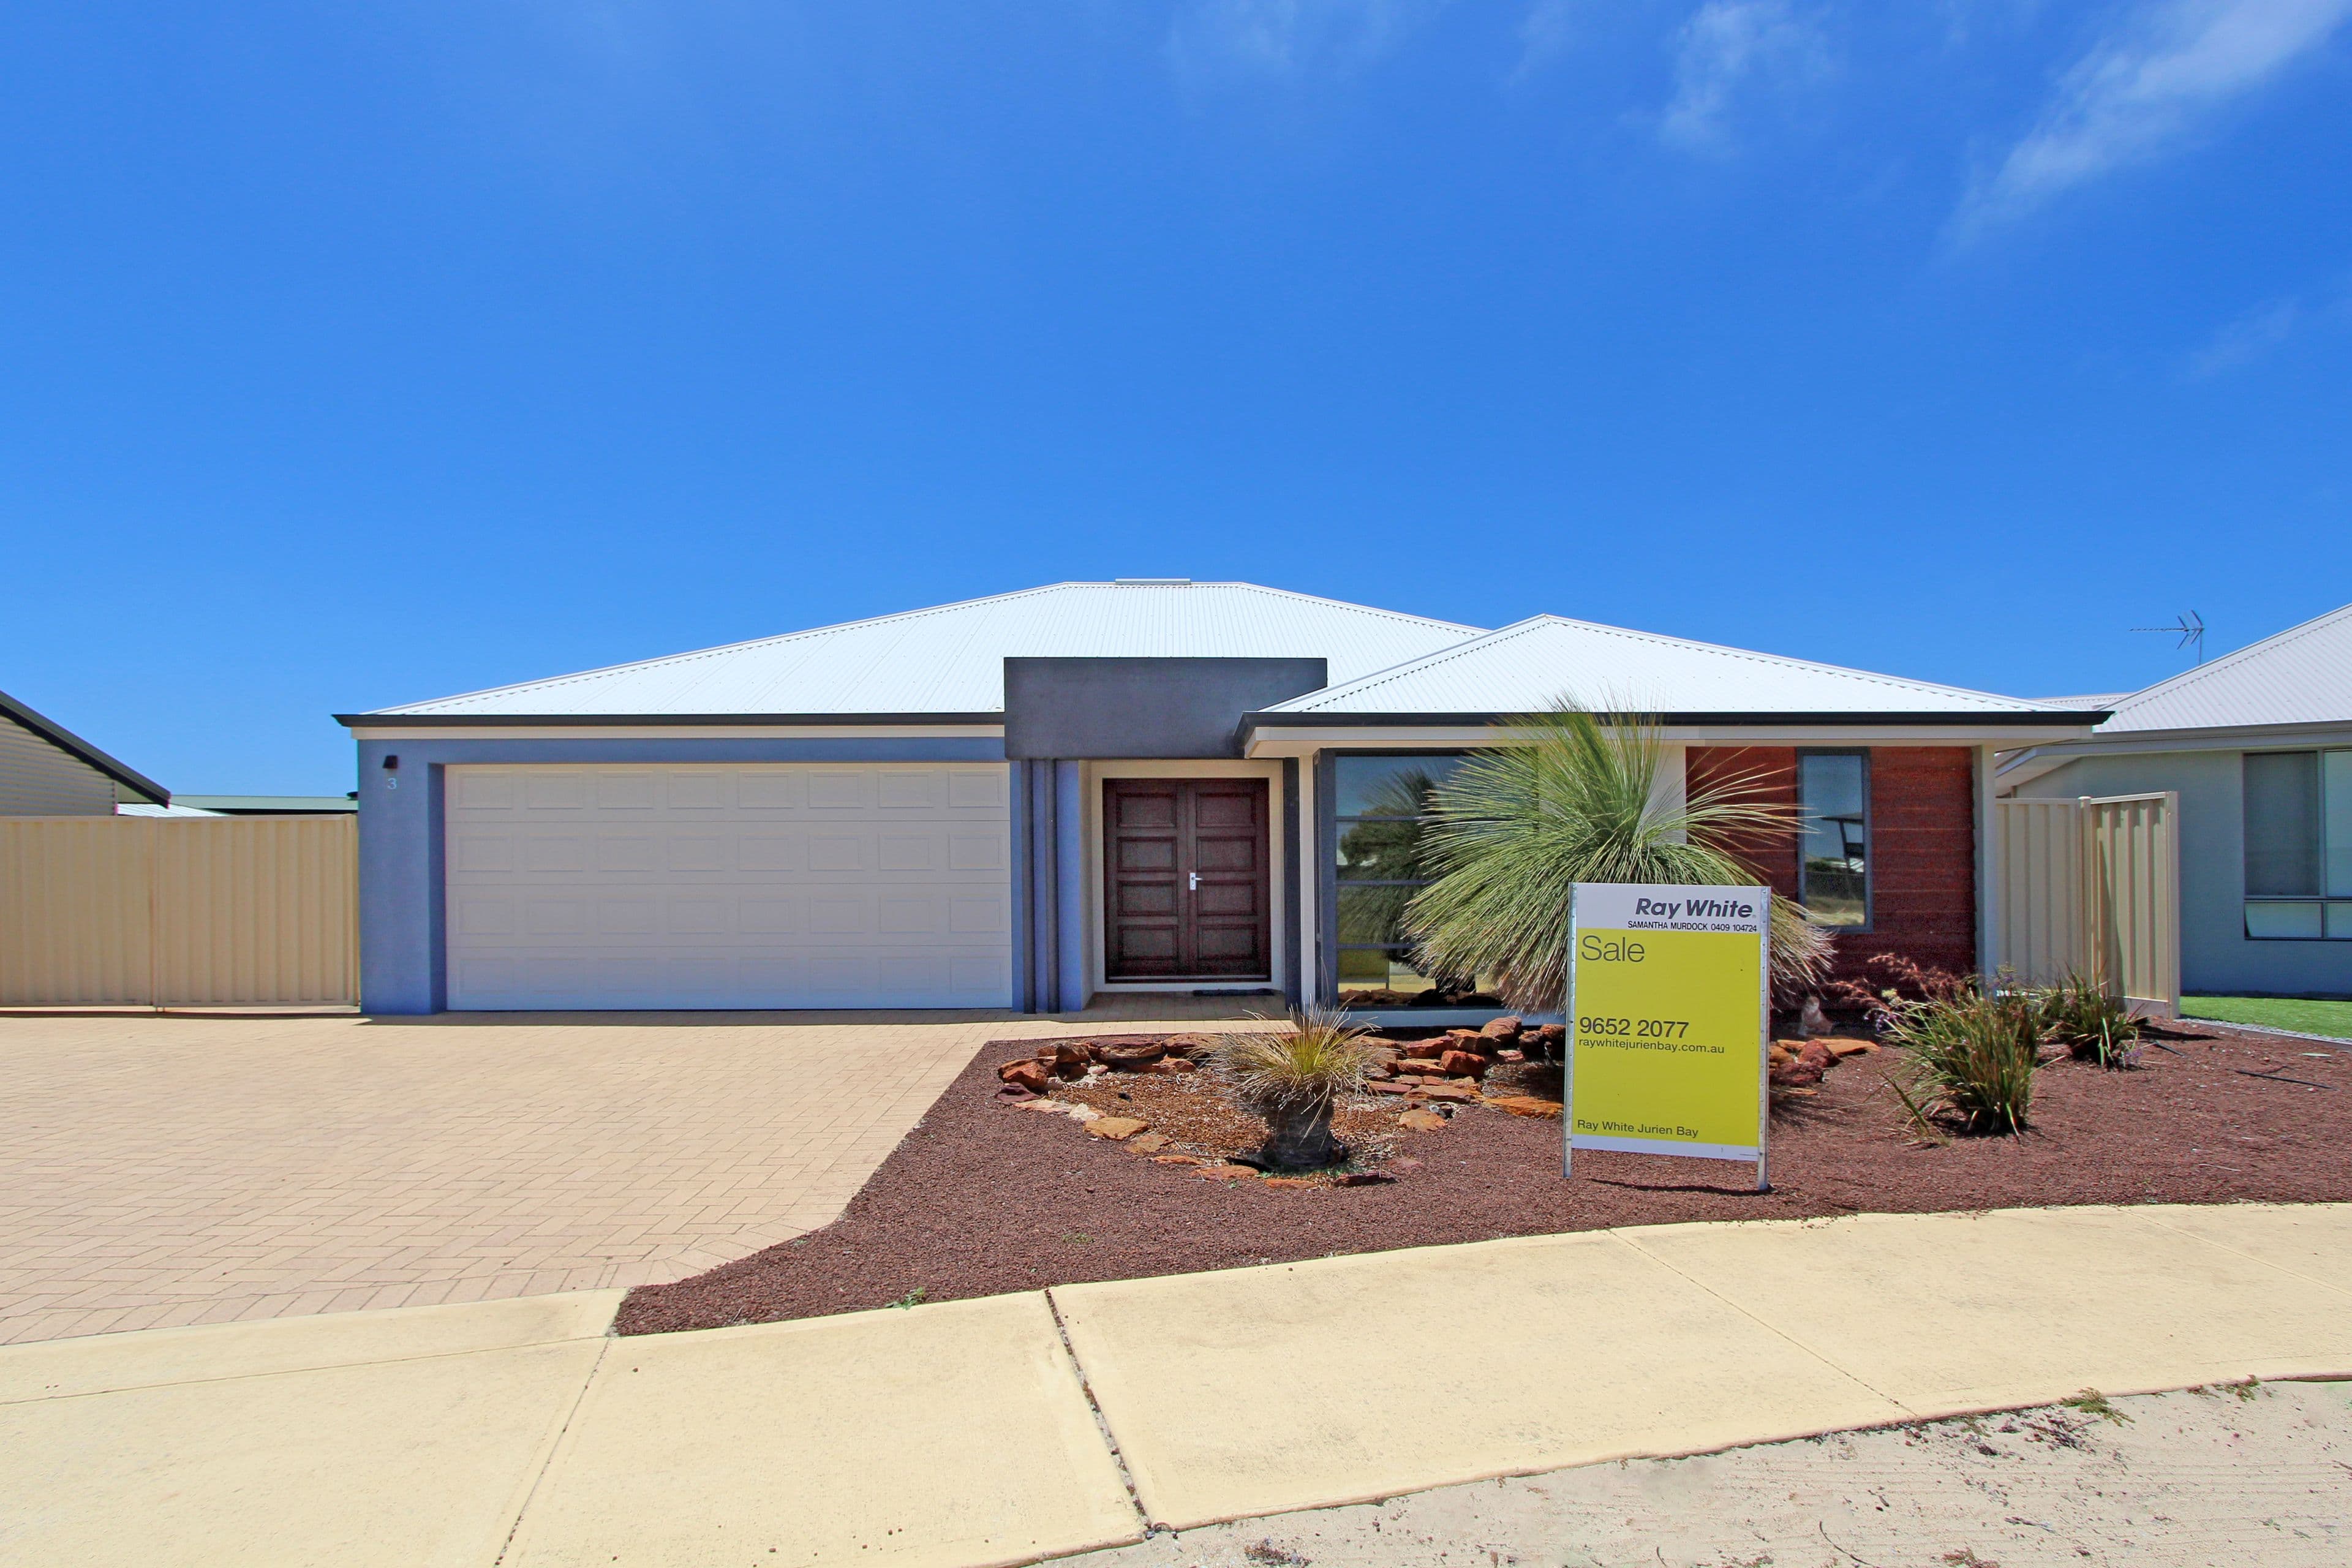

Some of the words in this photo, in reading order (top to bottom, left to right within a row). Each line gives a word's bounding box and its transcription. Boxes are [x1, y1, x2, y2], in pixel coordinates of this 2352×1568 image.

[387, 777, 397, 790] 3
[1635, 898, 1681, 919] Ray
[1686, 899, 1753, 918] White
[1627, 920, 1668, 929] SAMANTHA
[1670, 922, 1708, 931] MURDOCK
[1711, 923, 1730, 932] 0409
[1733, 924, 1757, 932] 104724
[1581, 935, 1645, 963] Sale
[1579, 1016, 1630, 1036] 9652
[1637, 1019, 1689, 1039] 2077
[1578, 1038, 1725, 1054] raywhitejurienbay.com.au
[1577, 1119, 1599, 1132] Ray
[1602, 1121, 1634, 1133] White
[1637, 1123, 1673, 1135] Jurien
[1676, 1126, 1698, 1139] Bay
